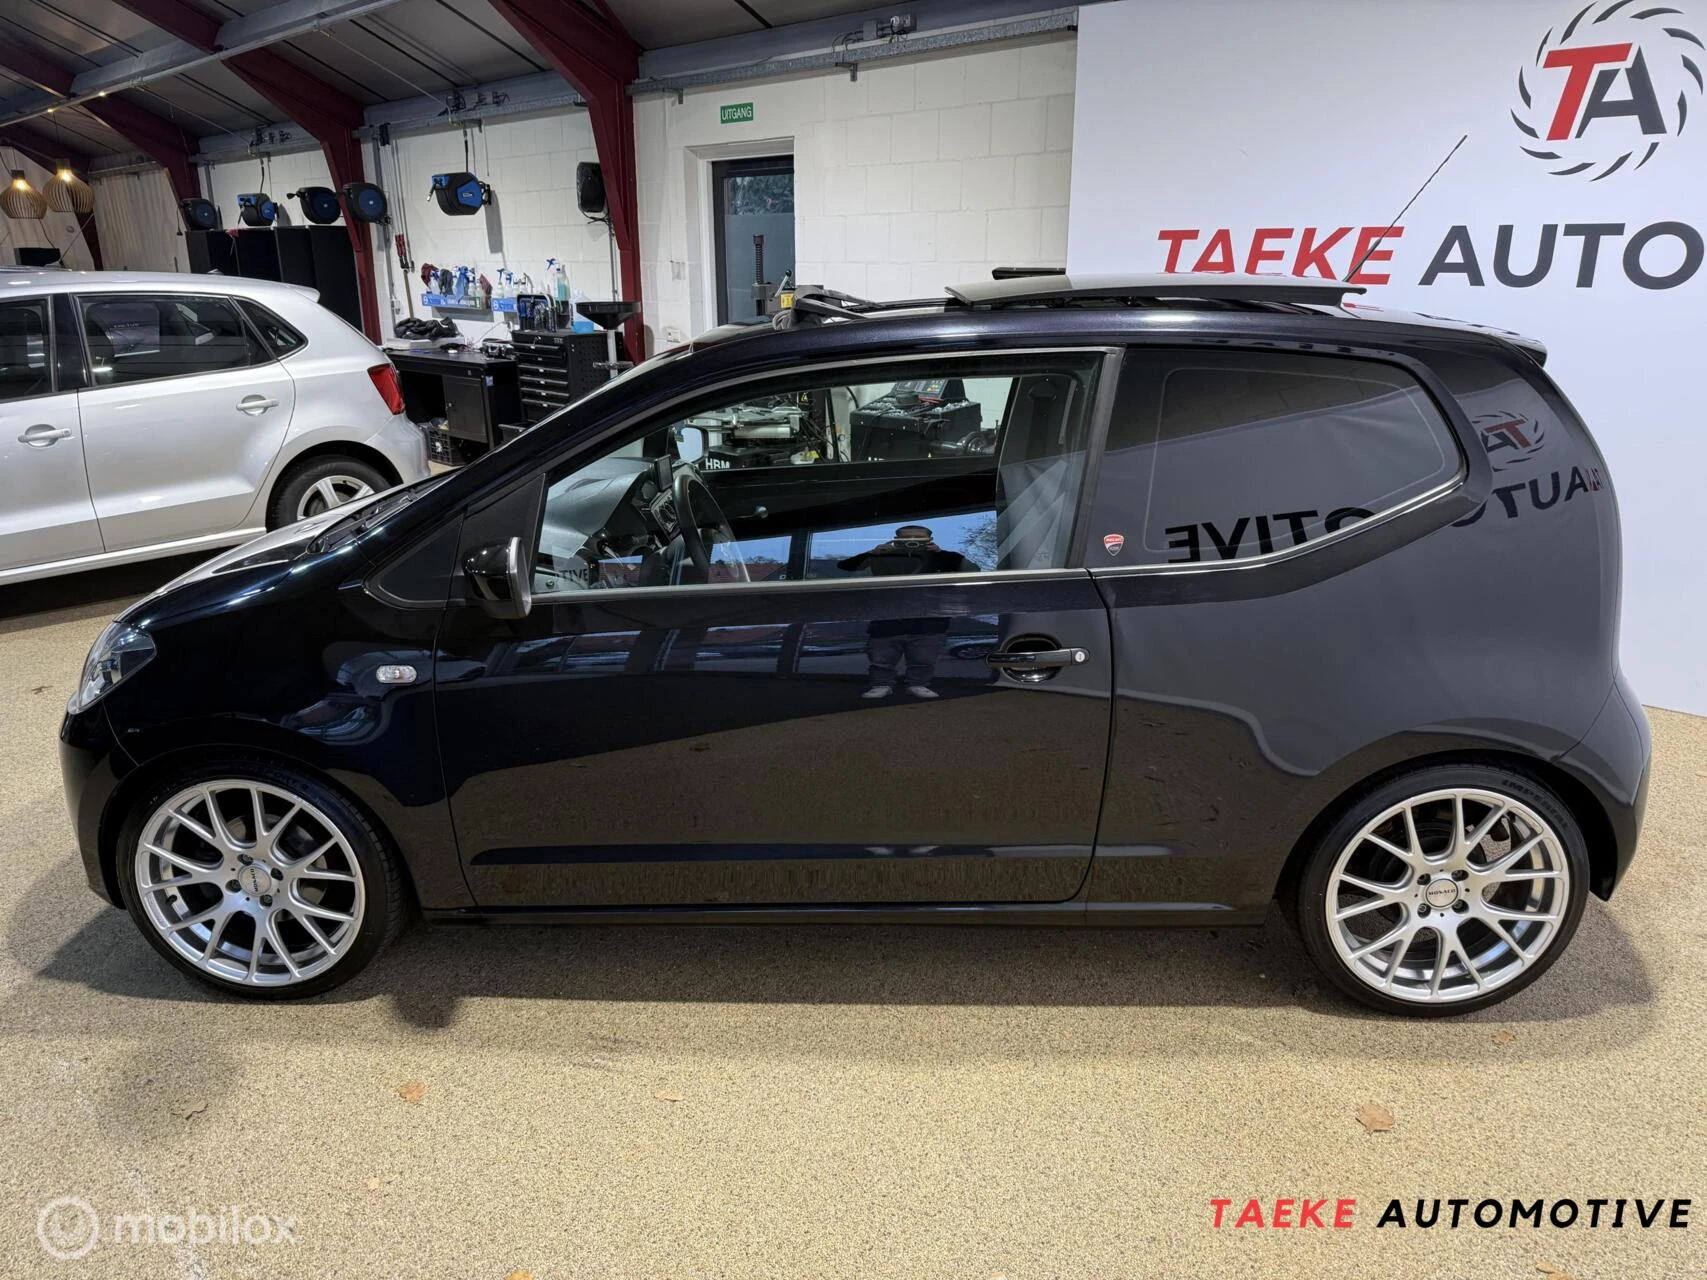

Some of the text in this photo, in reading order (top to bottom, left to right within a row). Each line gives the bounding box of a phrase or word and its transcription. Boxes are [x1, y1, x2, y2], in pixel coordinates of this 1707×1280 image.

[1543, 43, 1667, 141] TA
[722, 107, 752, 120] UITGANG
[1157, 221, 1705, 290] TAEKE AUTO
[1428, 888, 1456, 896] MONACO
